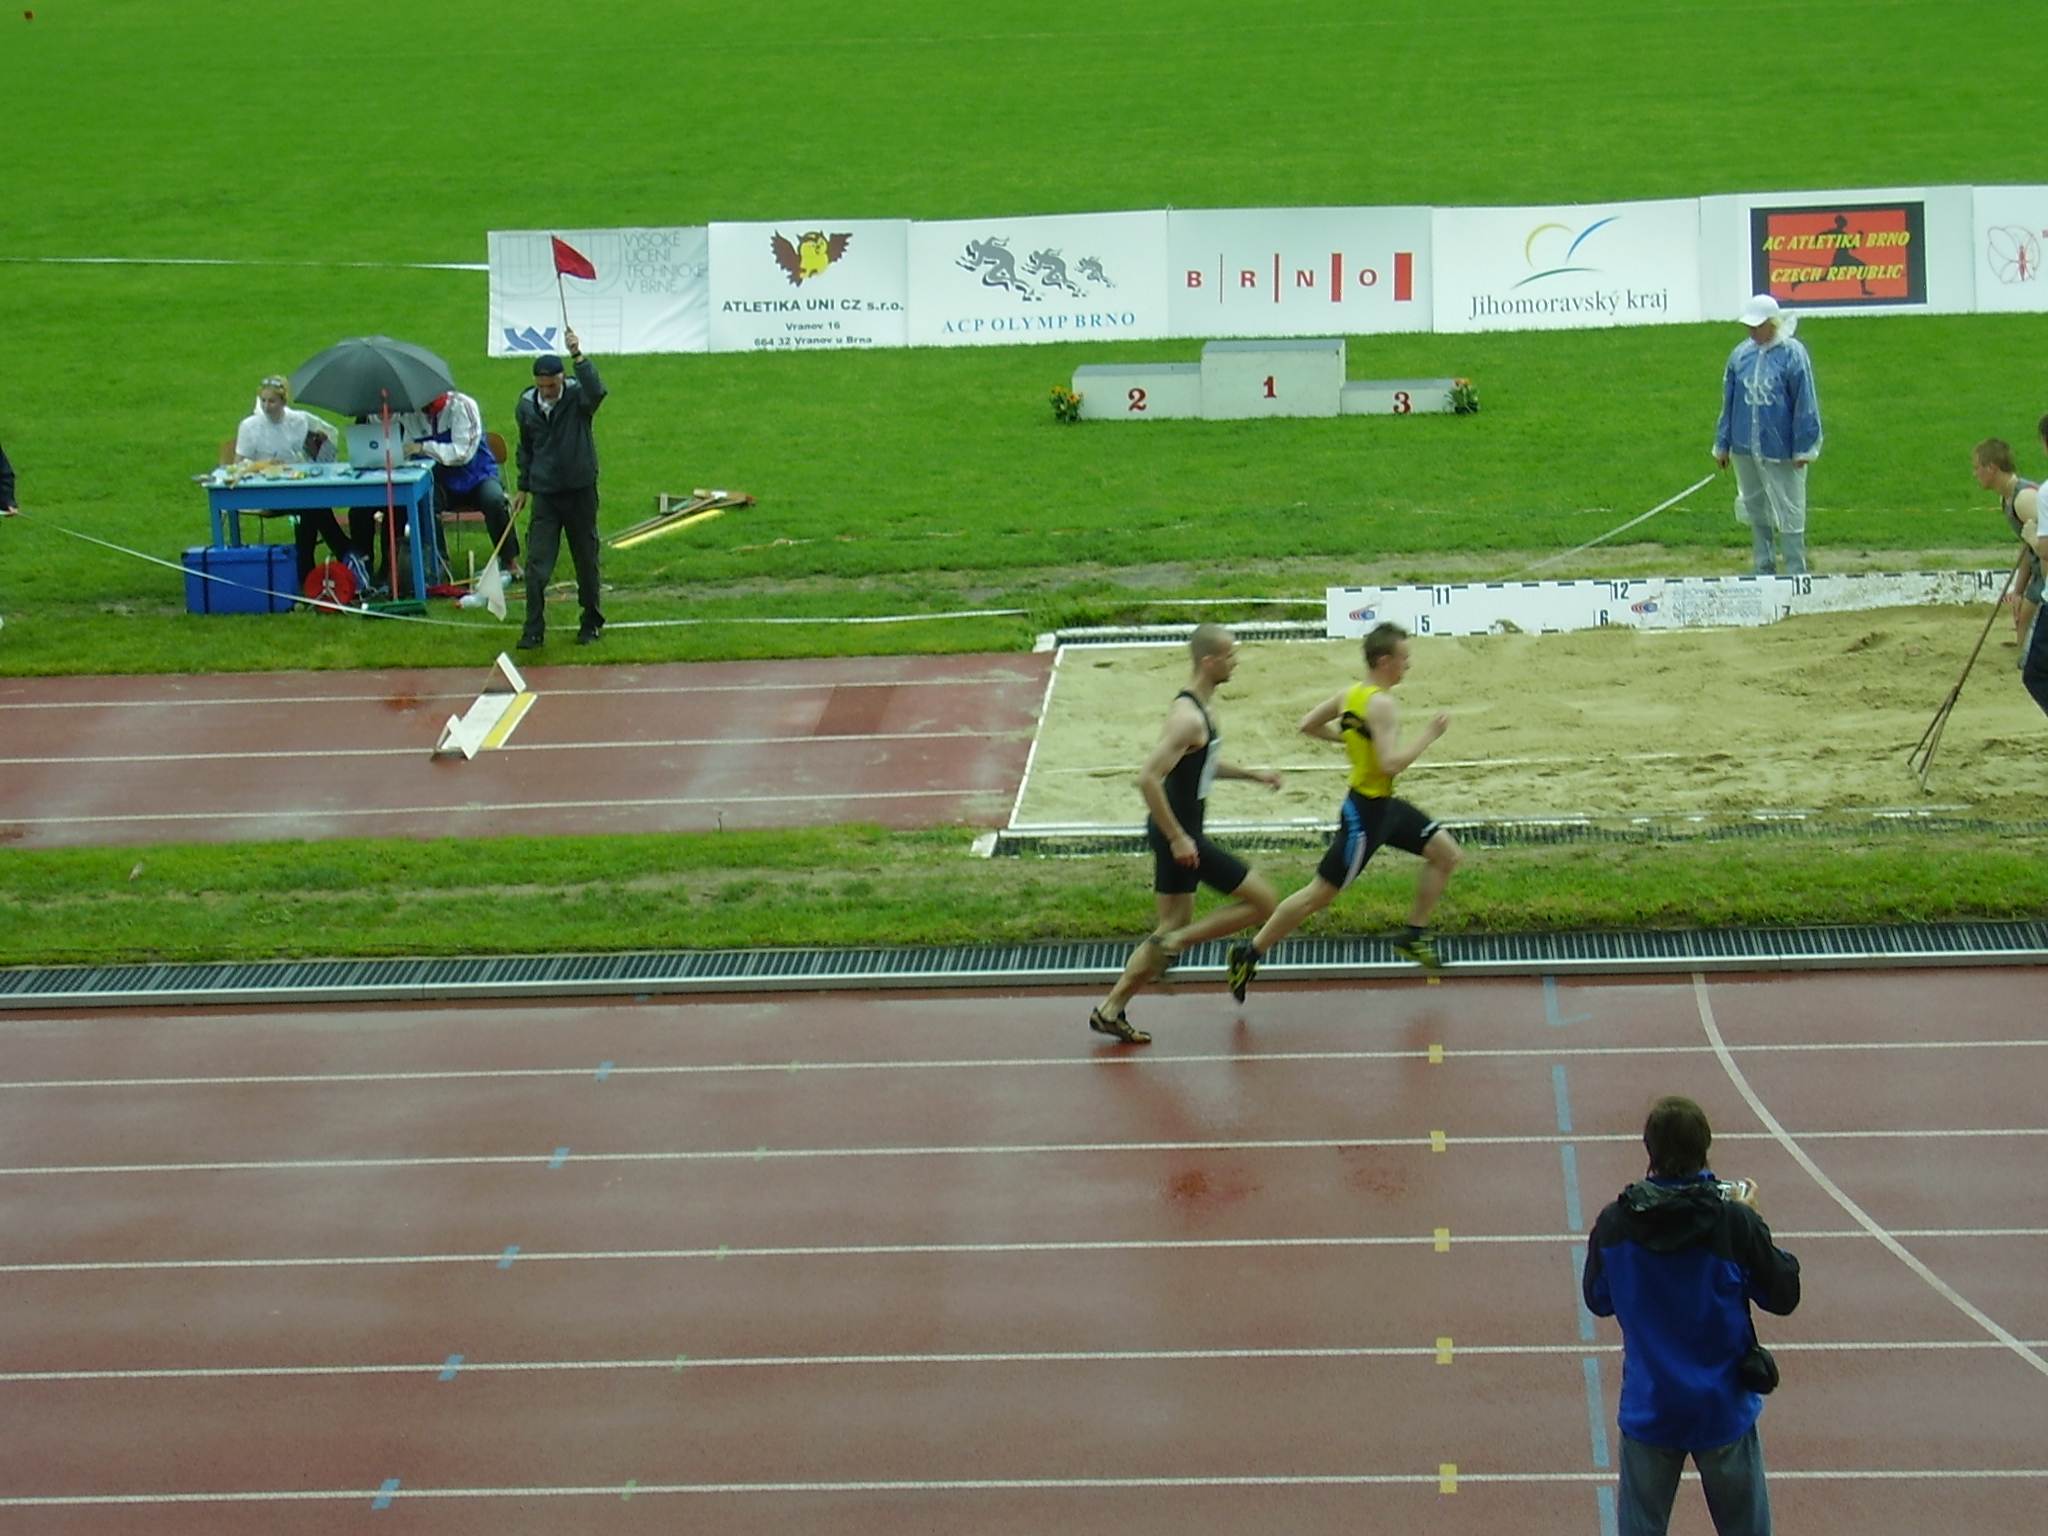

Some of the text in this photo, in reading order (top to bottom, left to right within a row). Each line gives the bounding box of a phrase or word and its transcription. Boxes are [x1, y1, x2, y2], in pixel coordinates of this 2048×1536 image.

[1762, 231, 1911, 251] AC ATLETIKA BRNO
[1771, 265, 1904, 283] CZECH REPUBLIC
[722, 299, 904, 312] ATLETIKA UNI CZ s.r.o.
[1469, 288, 1668, 320] Jihomoravský kraj
[786, 321, 841, 331] Vranov 16
[942, 312, 1136, 333] ACP OLYMP BRNO
[778, 337, 791, 346] 32
[795, 337, 832, 346] Vranov
[846, 335, 873, 345] Brna
[1263, 376, 1277, 398] 1
[1127, 387, 1147, 411] 2
[1392, 391, 1412, 414] 3
[1795, 577, 1812, 594] 13
[1978, 571, 1994, 590] 14
[1436, 587, 1450, 604] 11
[1613, 582, 1629, 599] 12
[1421, 615, 1430, 632] 5
[1600, 609, 1609, 626] 6
